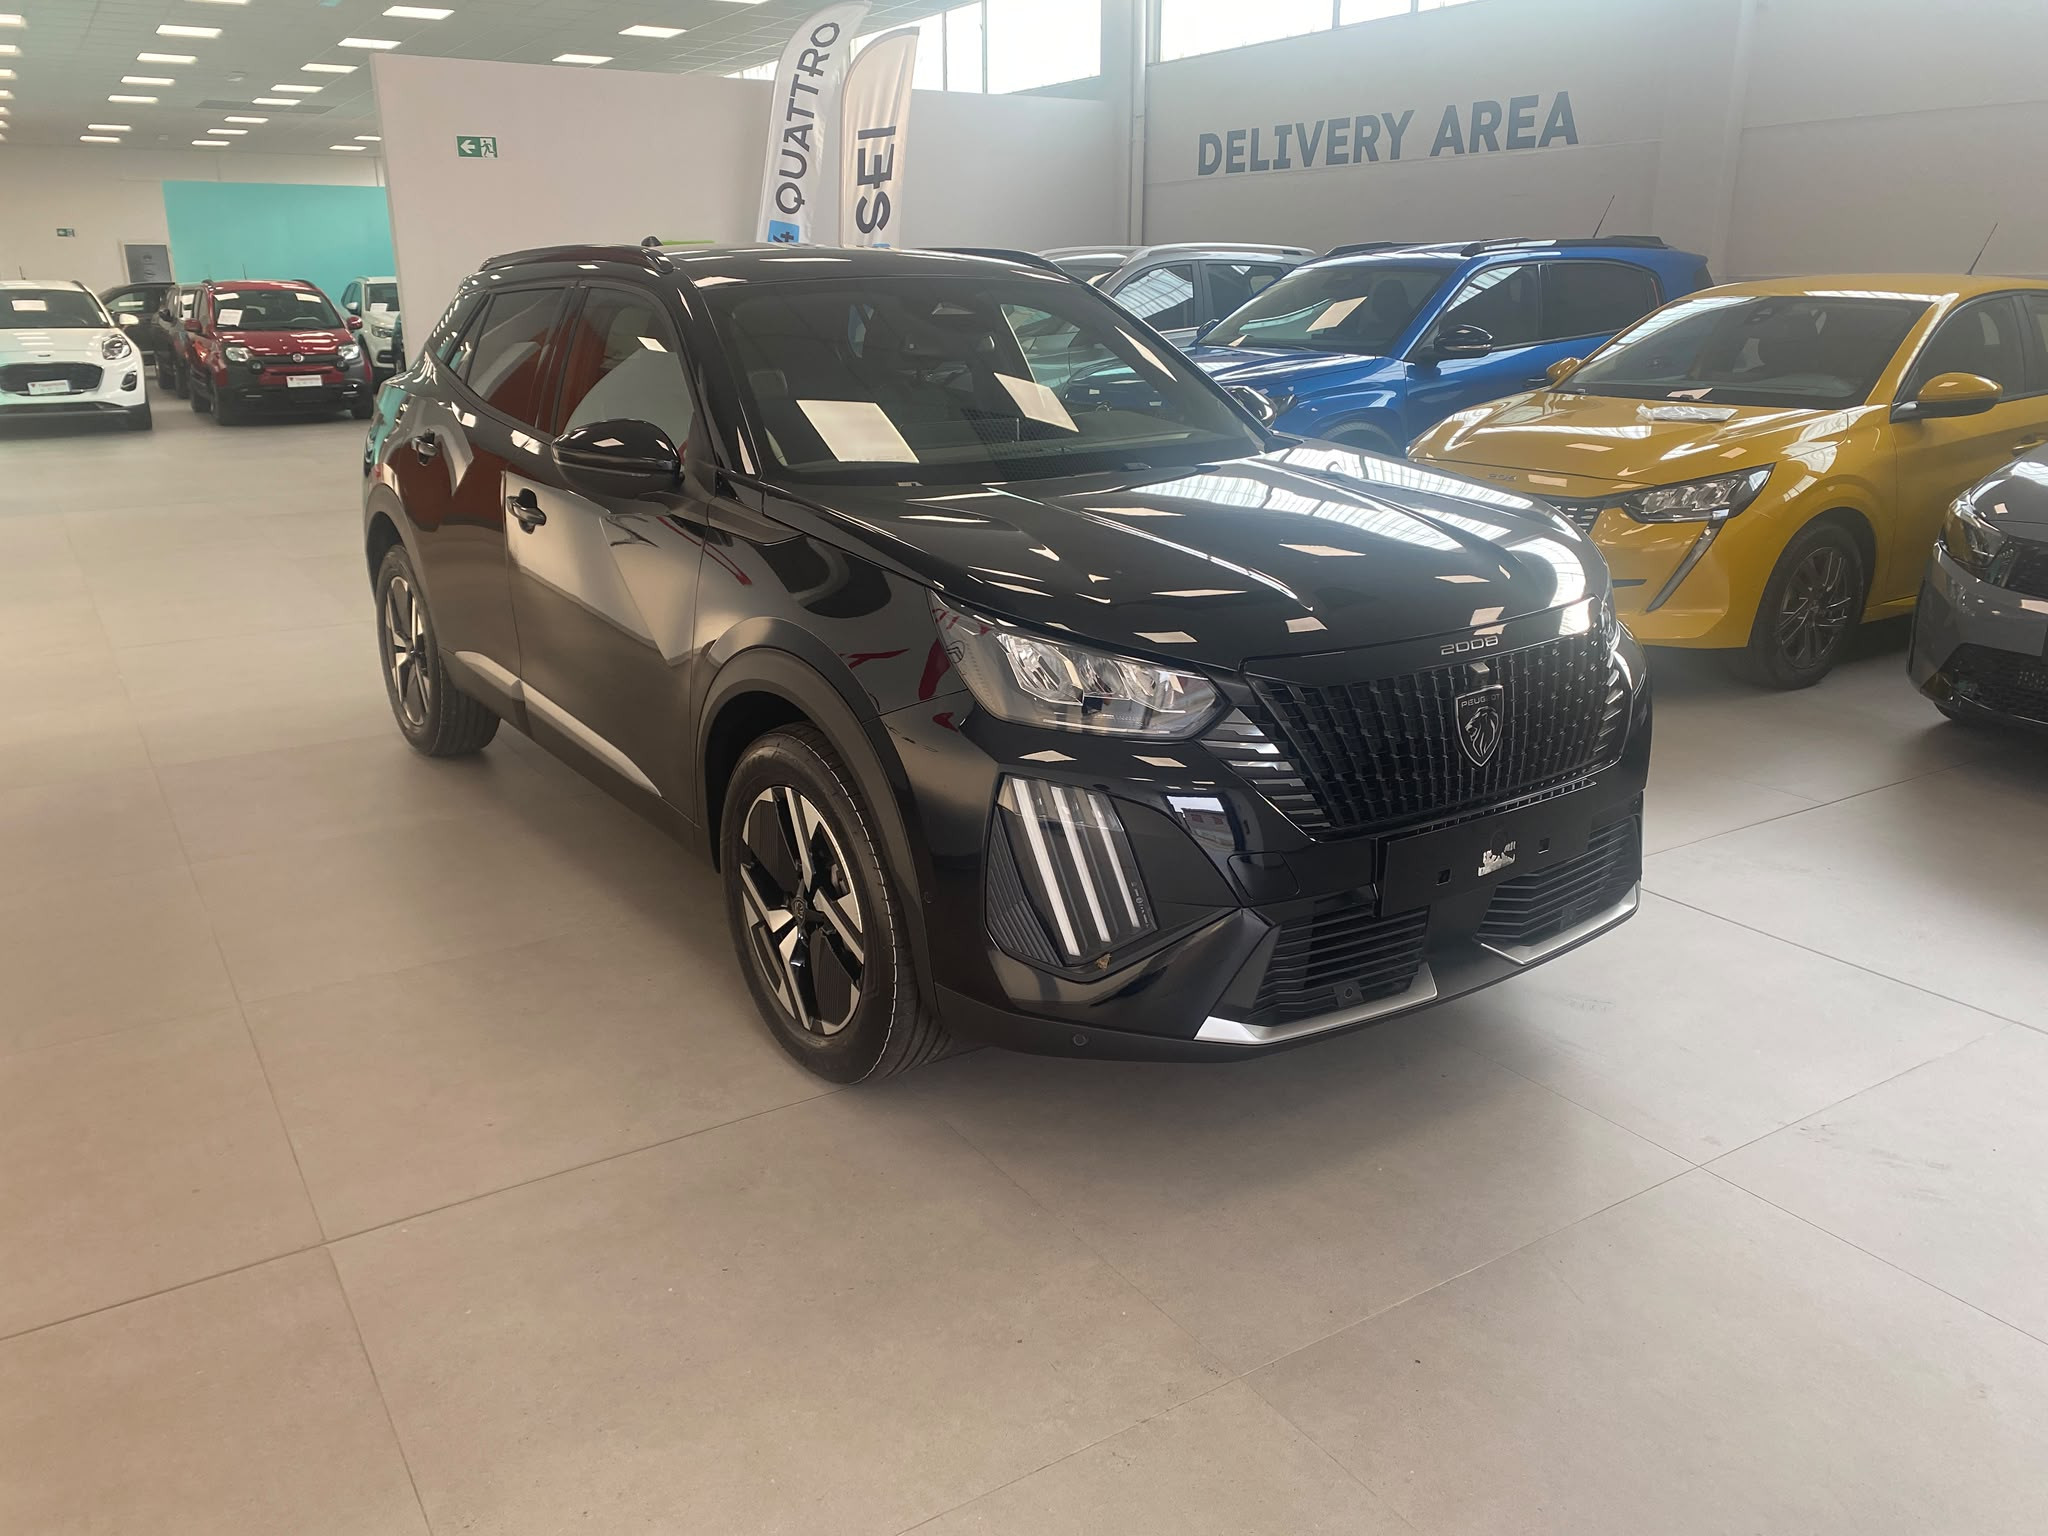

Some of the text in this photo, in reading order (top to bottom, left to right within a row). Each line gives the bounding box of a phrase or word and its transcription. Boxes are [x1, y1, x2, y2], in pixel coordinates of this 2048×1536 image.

[776, 22, 840, 214] QUATTRO
[1197, 91, 1579, 176] DELIVERY AREA
[855, 125, 897, 235] SEI
[1440, 635, 1499, 656] 2008
[1461, 693, 1501, 709] PEUGOT
